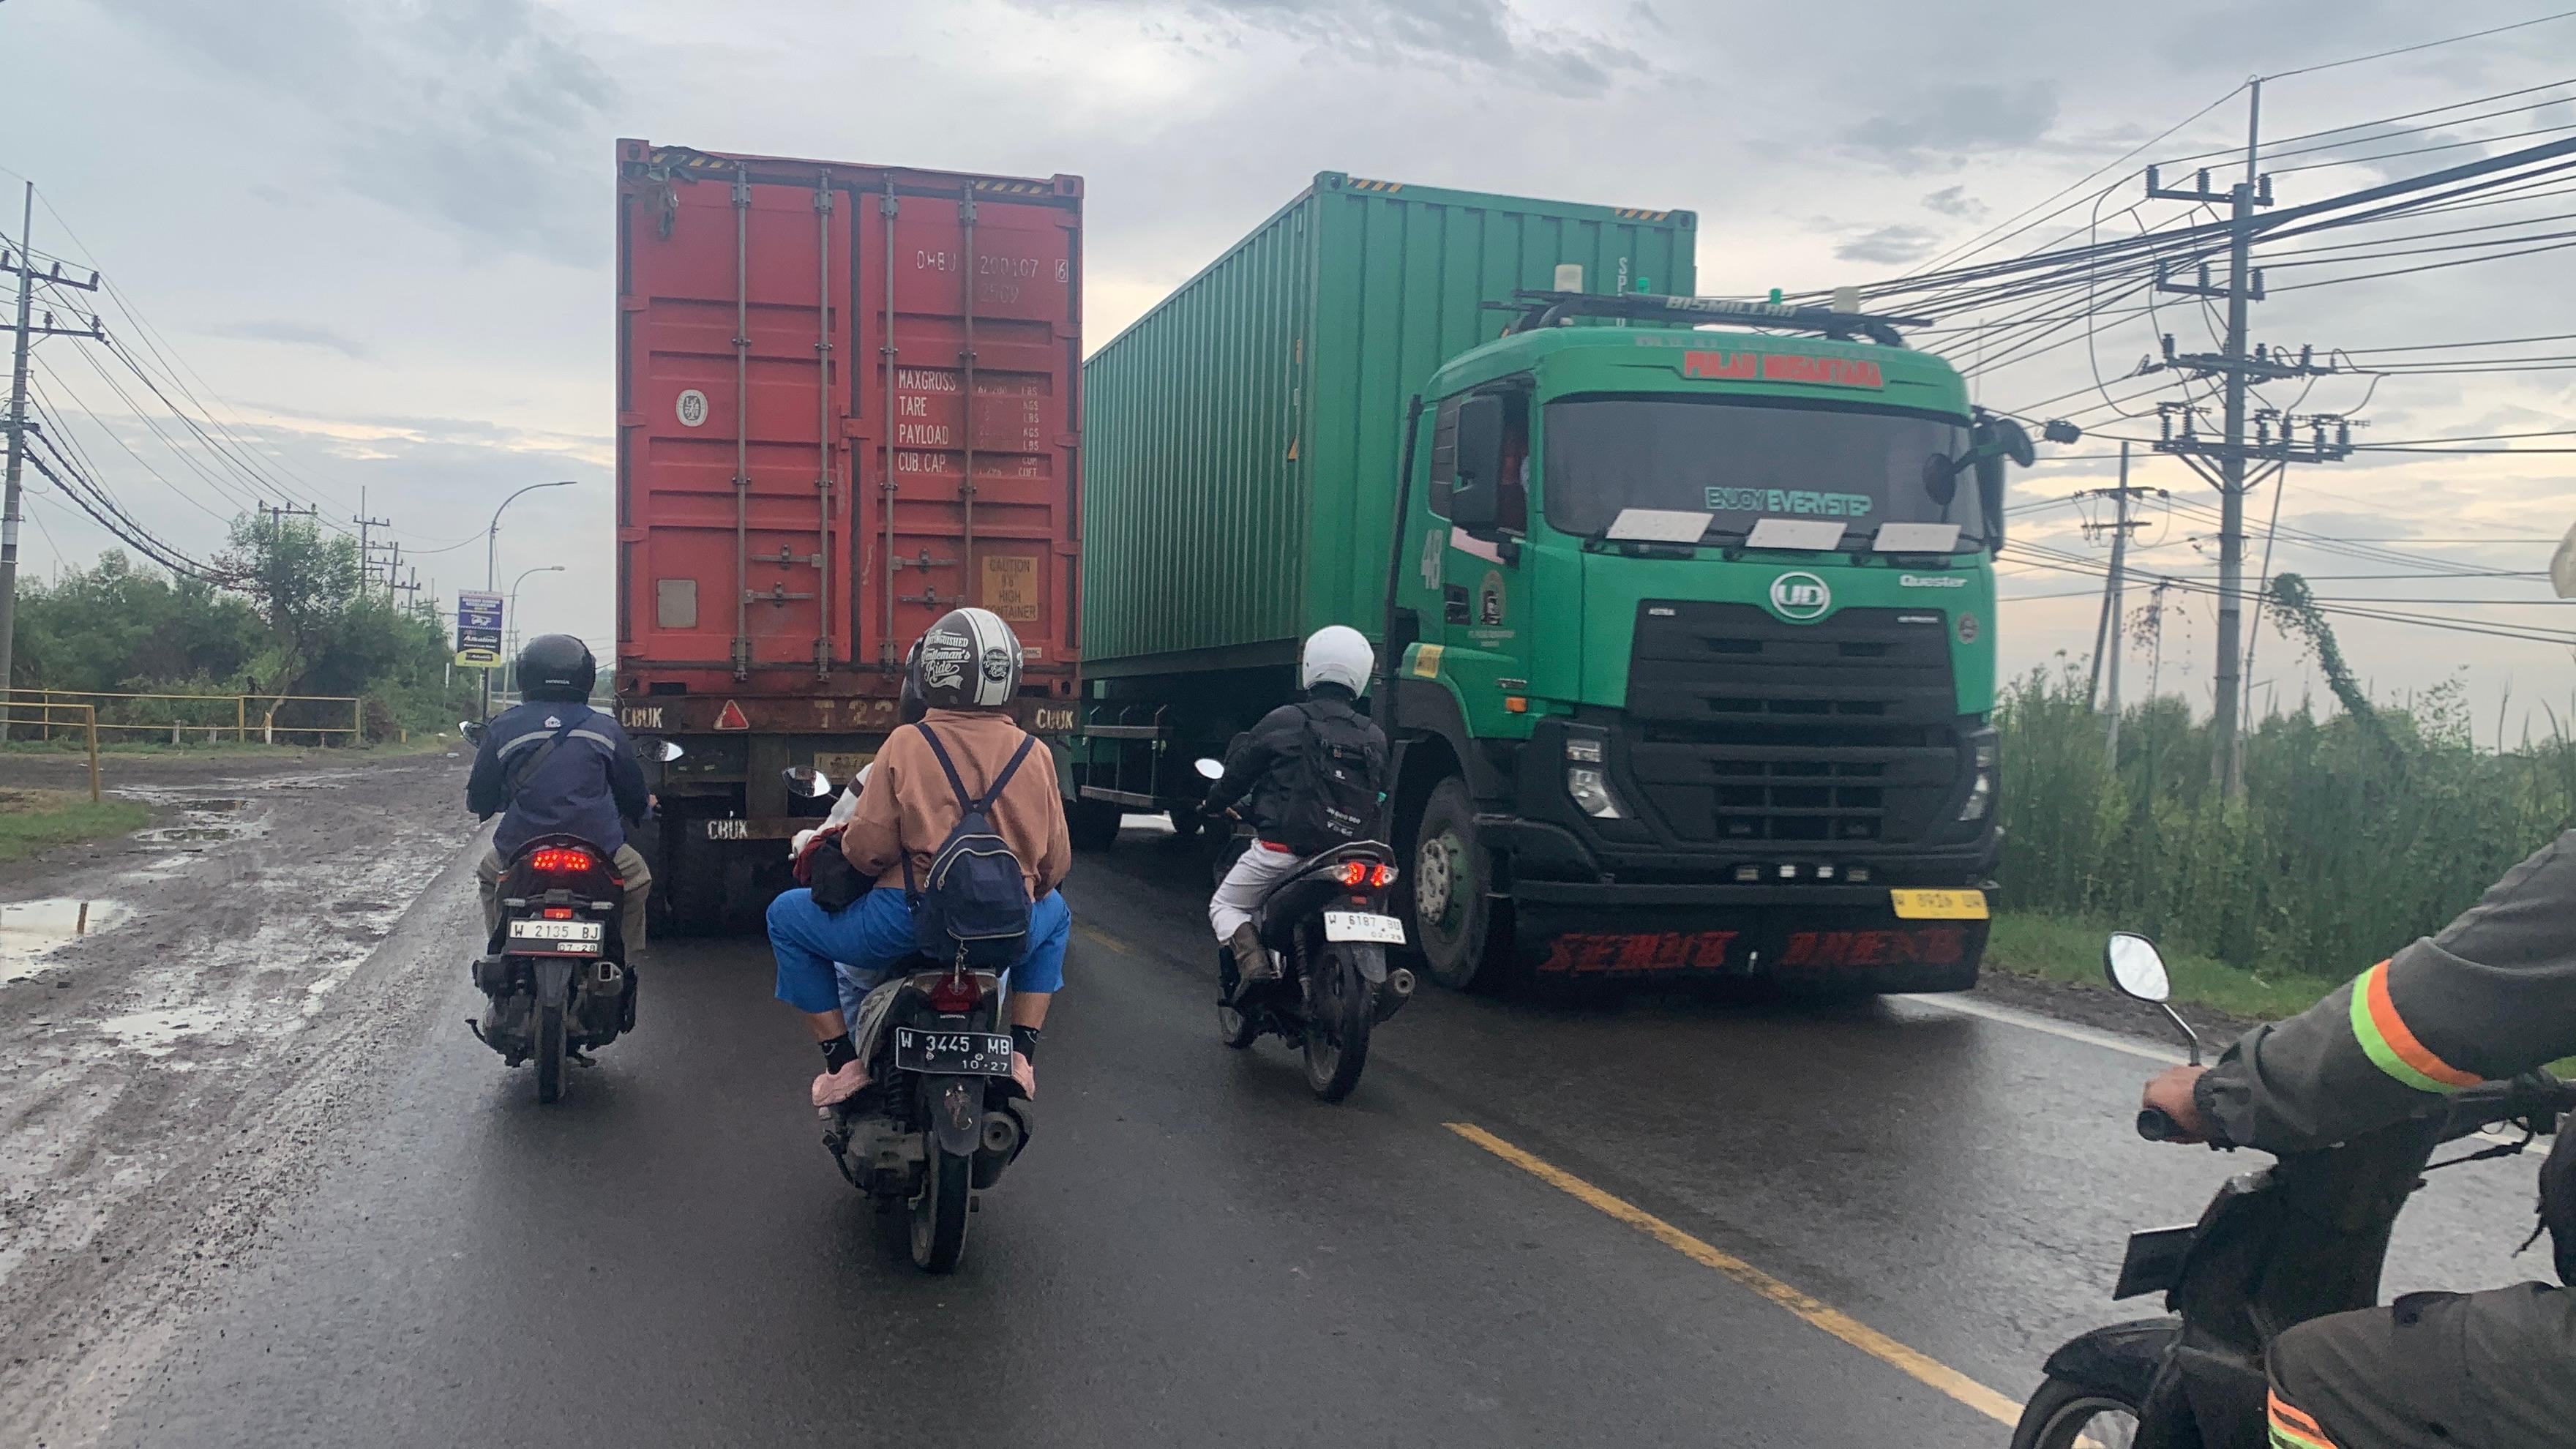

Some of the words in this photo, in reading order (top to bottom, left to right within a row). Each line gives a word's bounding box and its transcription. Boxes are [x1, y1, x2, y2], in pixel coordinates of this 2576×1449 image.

[899, 369, 956, 391] MAXGROSS
[899, 396, 927, 416] TARE
[899, 424, 949, 445] PAYLOAD
[999, 590, 1021, 603] HIGH
[1778, 585, 1824, 606] UD
[924, 659, 959, 682] Ride
[1328, 915, 1336, 925] W
[1349, 916, 1376, 926] 6187
[514, 924, 524, 937] W
[535, 925, 569, 937] 2135
[582, 926, 599, 939] BJ
[901, 1031, 913, 1048] W
[926, 1036, 970, 1052] 3445
[988, 1038, 1010, 1055] MB
